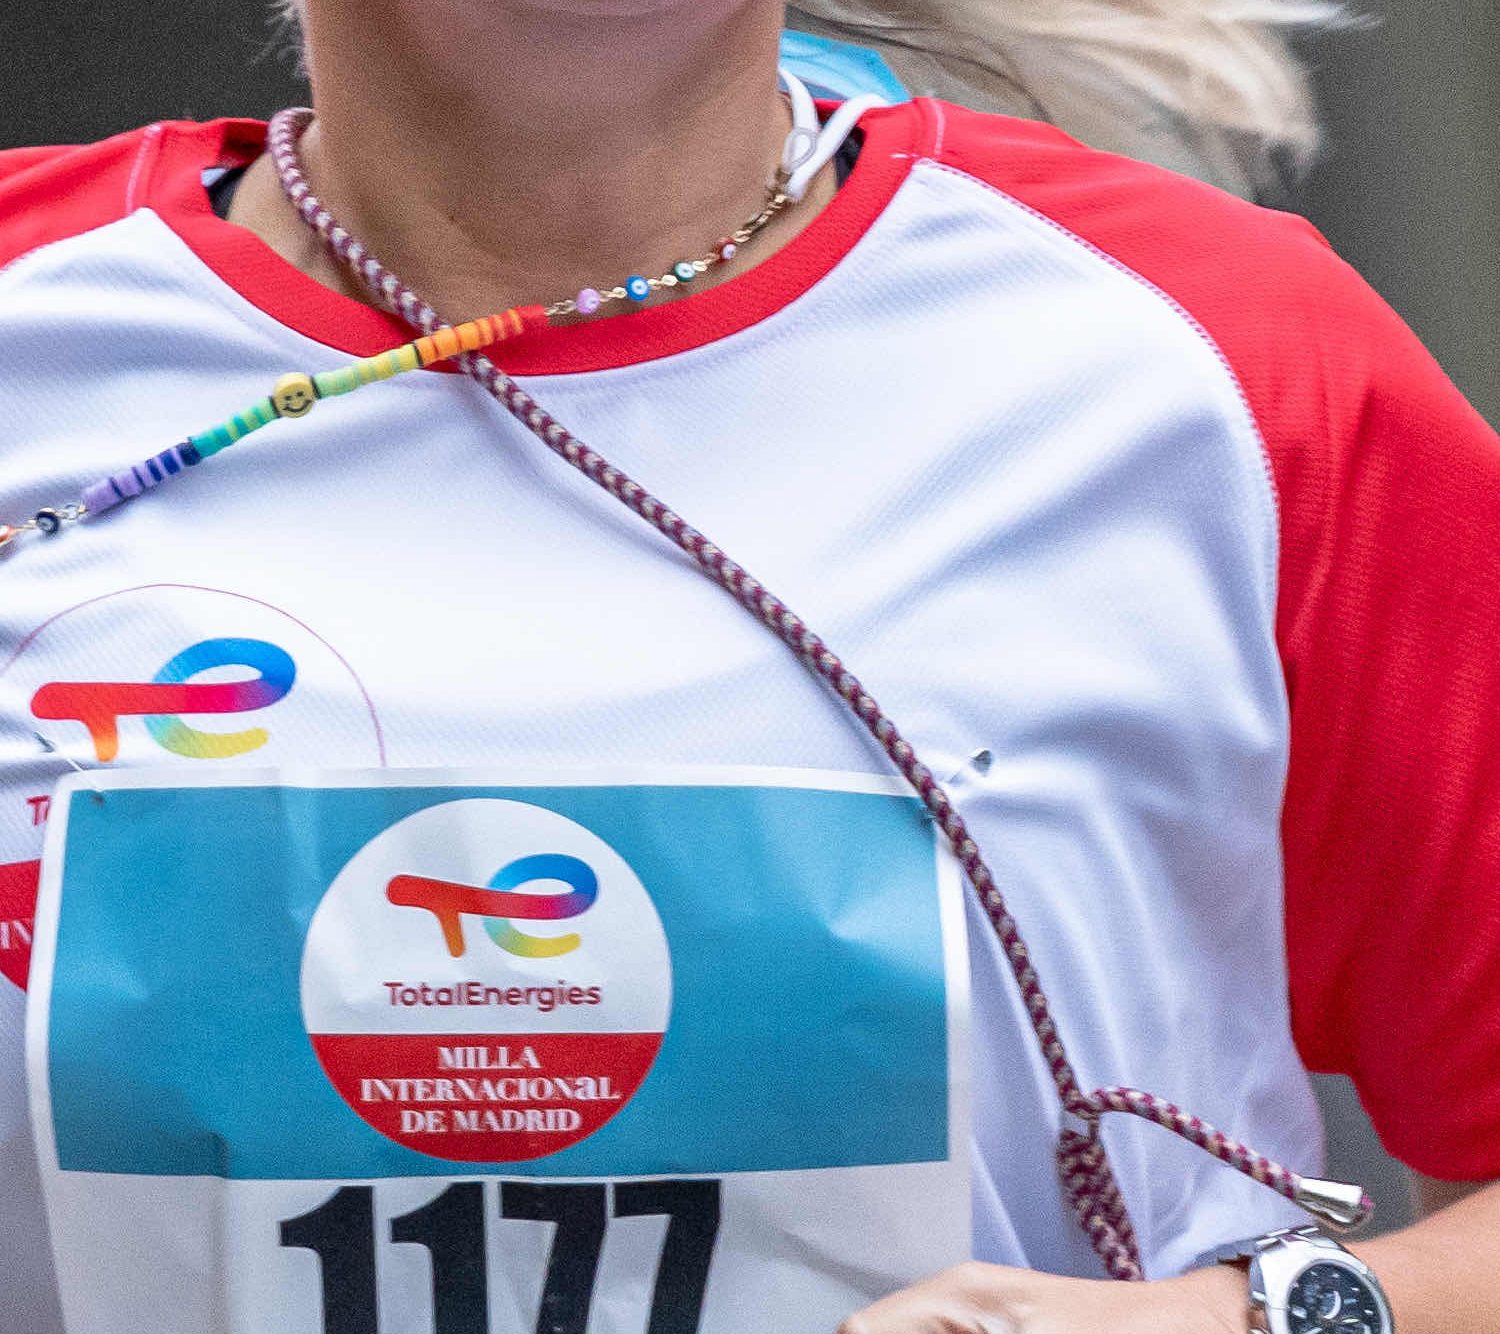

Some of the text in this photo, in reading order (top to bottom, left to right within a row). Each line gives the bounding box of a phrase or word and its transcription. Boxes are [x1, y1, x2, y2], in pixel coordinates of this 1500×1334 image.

[384, 980, 602, 1012] TotalEnergies
[439, 1046, 541, 1070] MILLA
[401, 1108, 581, 1133] DE MADRID
